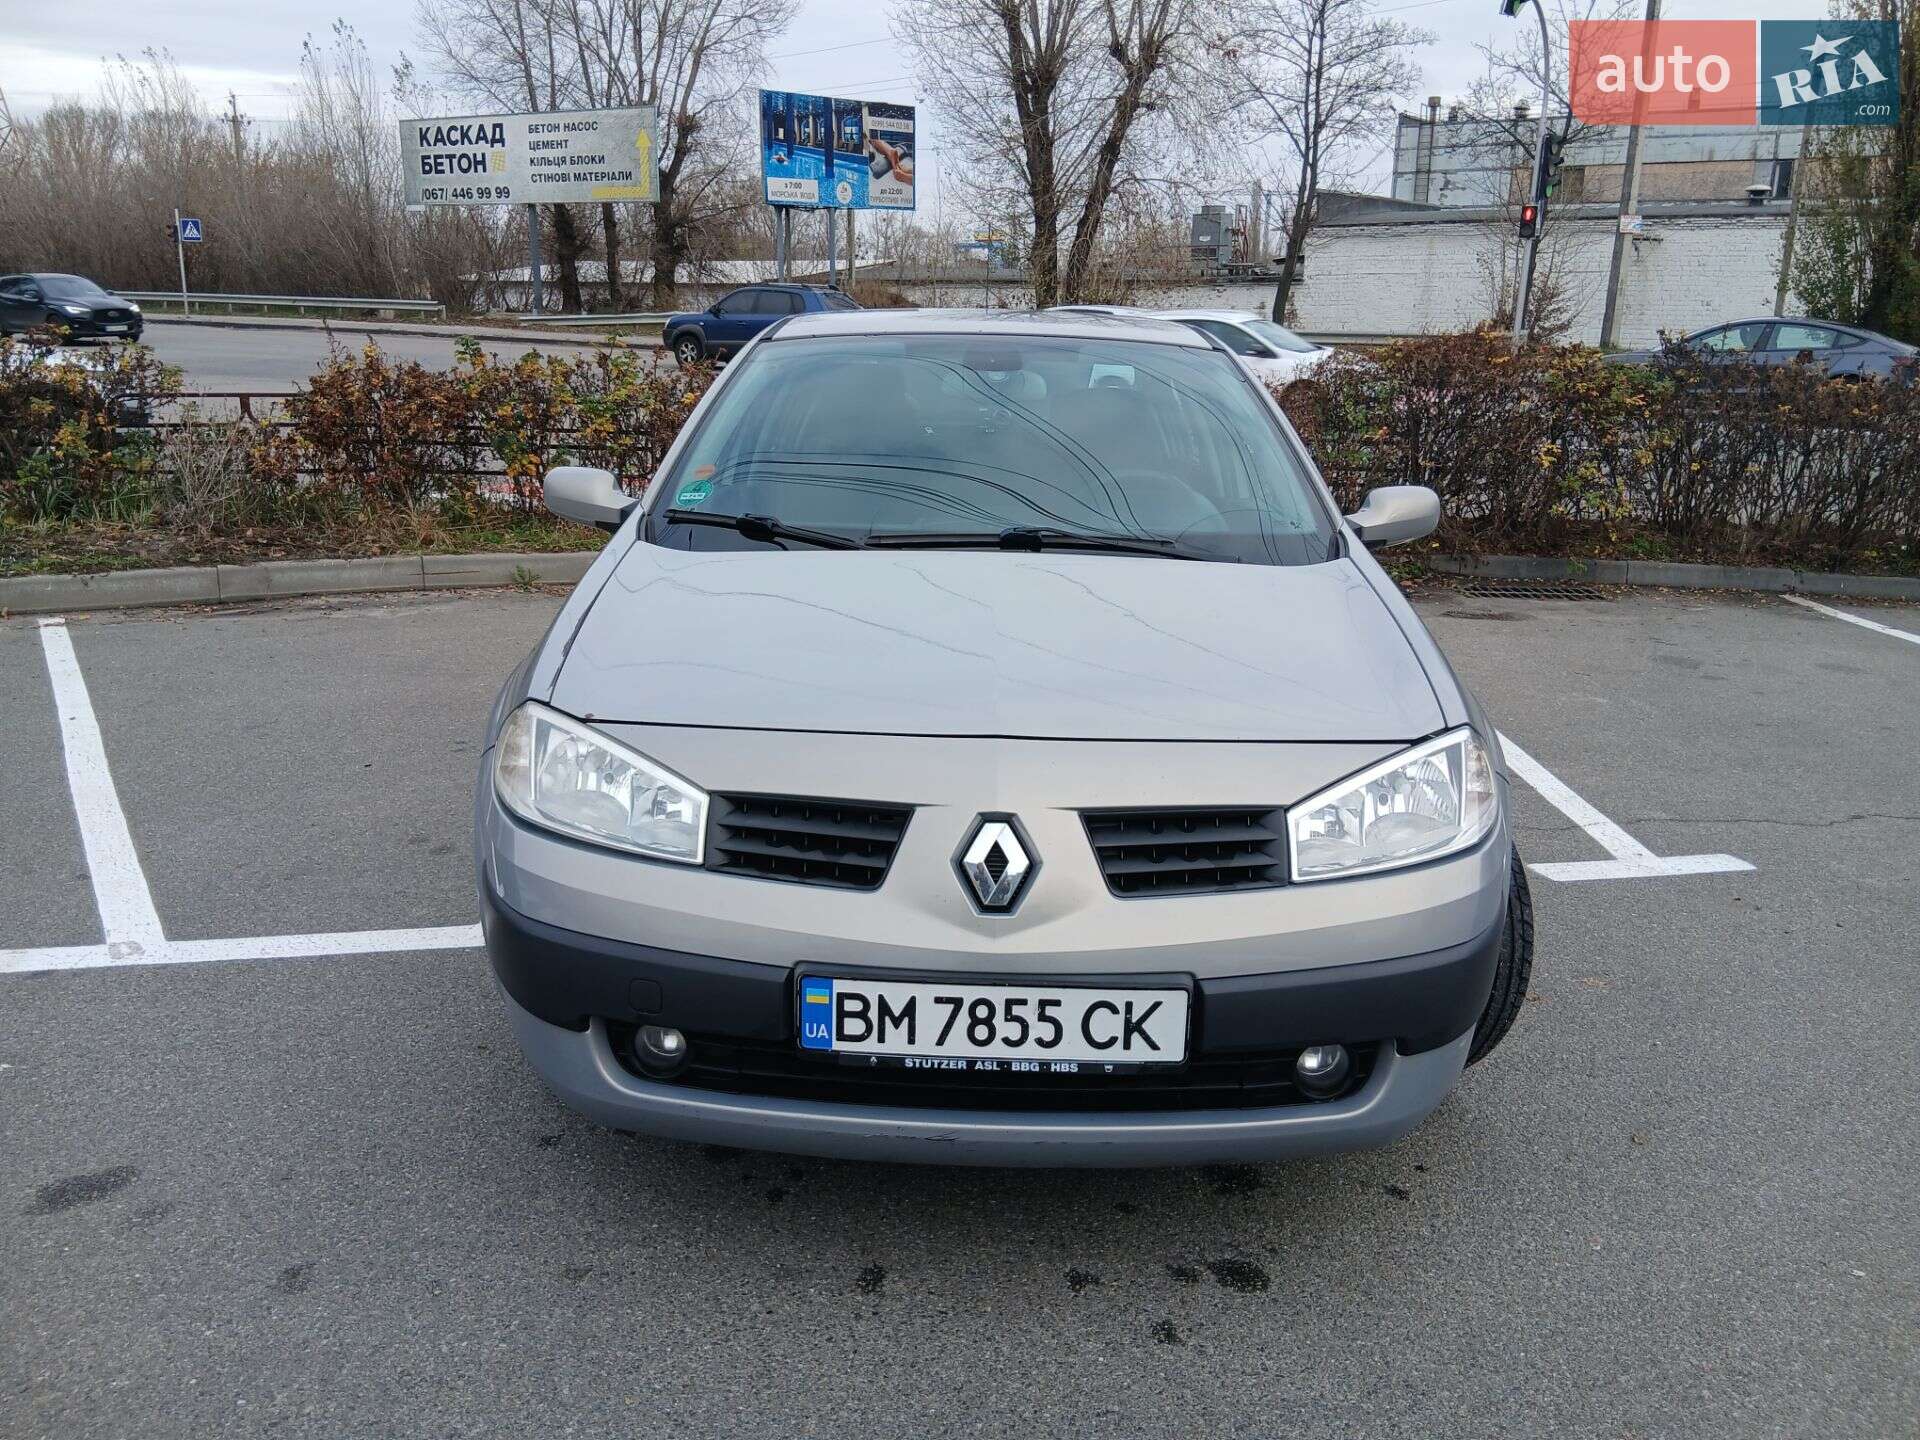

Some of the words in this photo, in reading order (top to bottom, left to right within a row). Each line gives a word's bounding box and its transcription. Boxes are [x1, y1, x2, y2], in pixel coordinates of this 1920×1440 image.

[528, 123, 561, 134] БЕТОН
[563, 121, 598, 133] НАСОС
[419, 122, 506, 148] КАСКАД
[529, 139, 569, 151] ЦЕМЕНТ
[421, 152, 487, 175] БЕТОН
[529, 157, 567, 169] КІЛЬЦЯ
[570, 155, 605, 166] БЛОКИ
[531, 173, 571, 184] СТІНОВІ
[573, 171, 633, 182] МАТЕРІАЛИ
[451, 187, 474, 200] 446
[477, 187, 493, 199] 99
[495, 186, 511, 199] 99
[836, 992, 916, 1045] BM
[934, 996, 1063, 1049] 7855
[1081, 1000, 1163, 1051] CK
[805, 1023, 829, 1039] UA
[975, 1060, 1000, 1071] ASL
[1012, 1061, 1040, 1072] BBG
[1051, 1062, 1079, 1073] HBS
